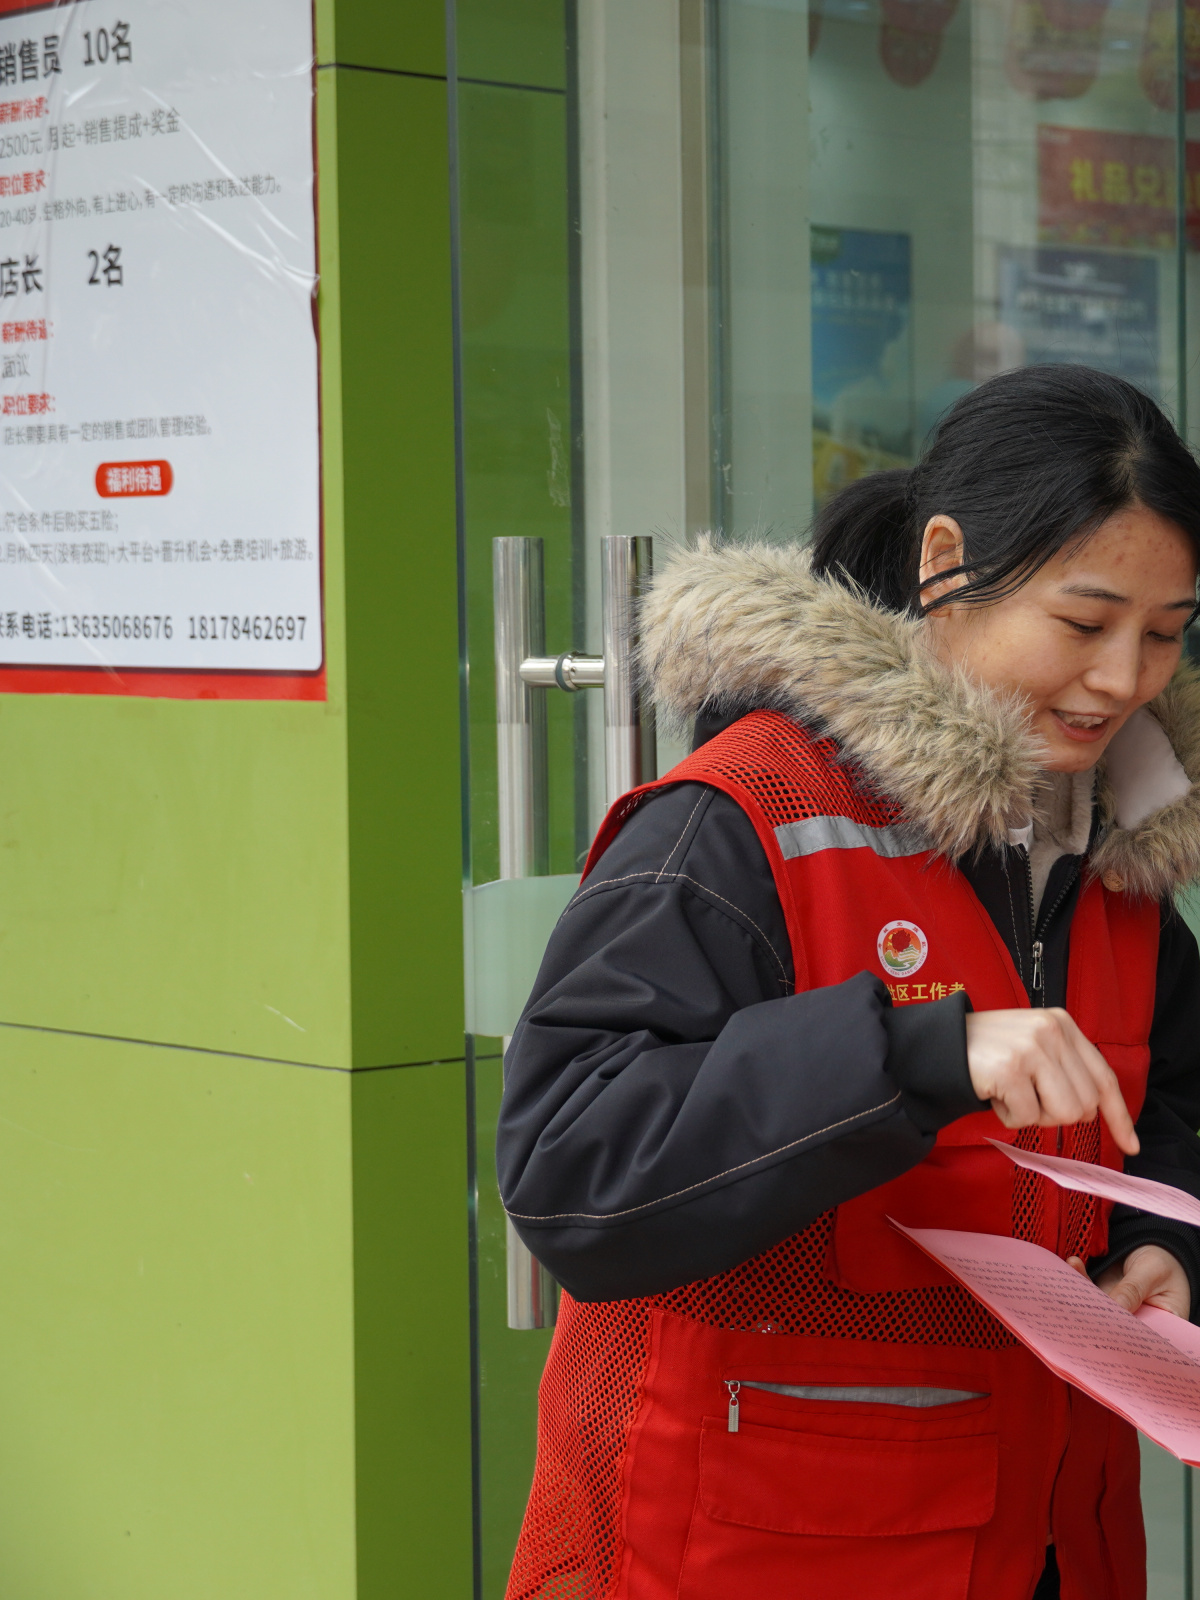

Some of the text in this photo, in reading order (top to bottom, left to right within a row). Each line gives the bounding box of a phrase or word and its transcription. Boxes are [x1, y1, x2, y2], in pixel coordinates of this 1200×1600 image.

[0, 20, 132, 87] 销售员 10名
[0, 244, 124, 299] 店长 2名
[106, 466, 163, 493] 福利待遇
[188, 615, 307, 640] 18178462697
